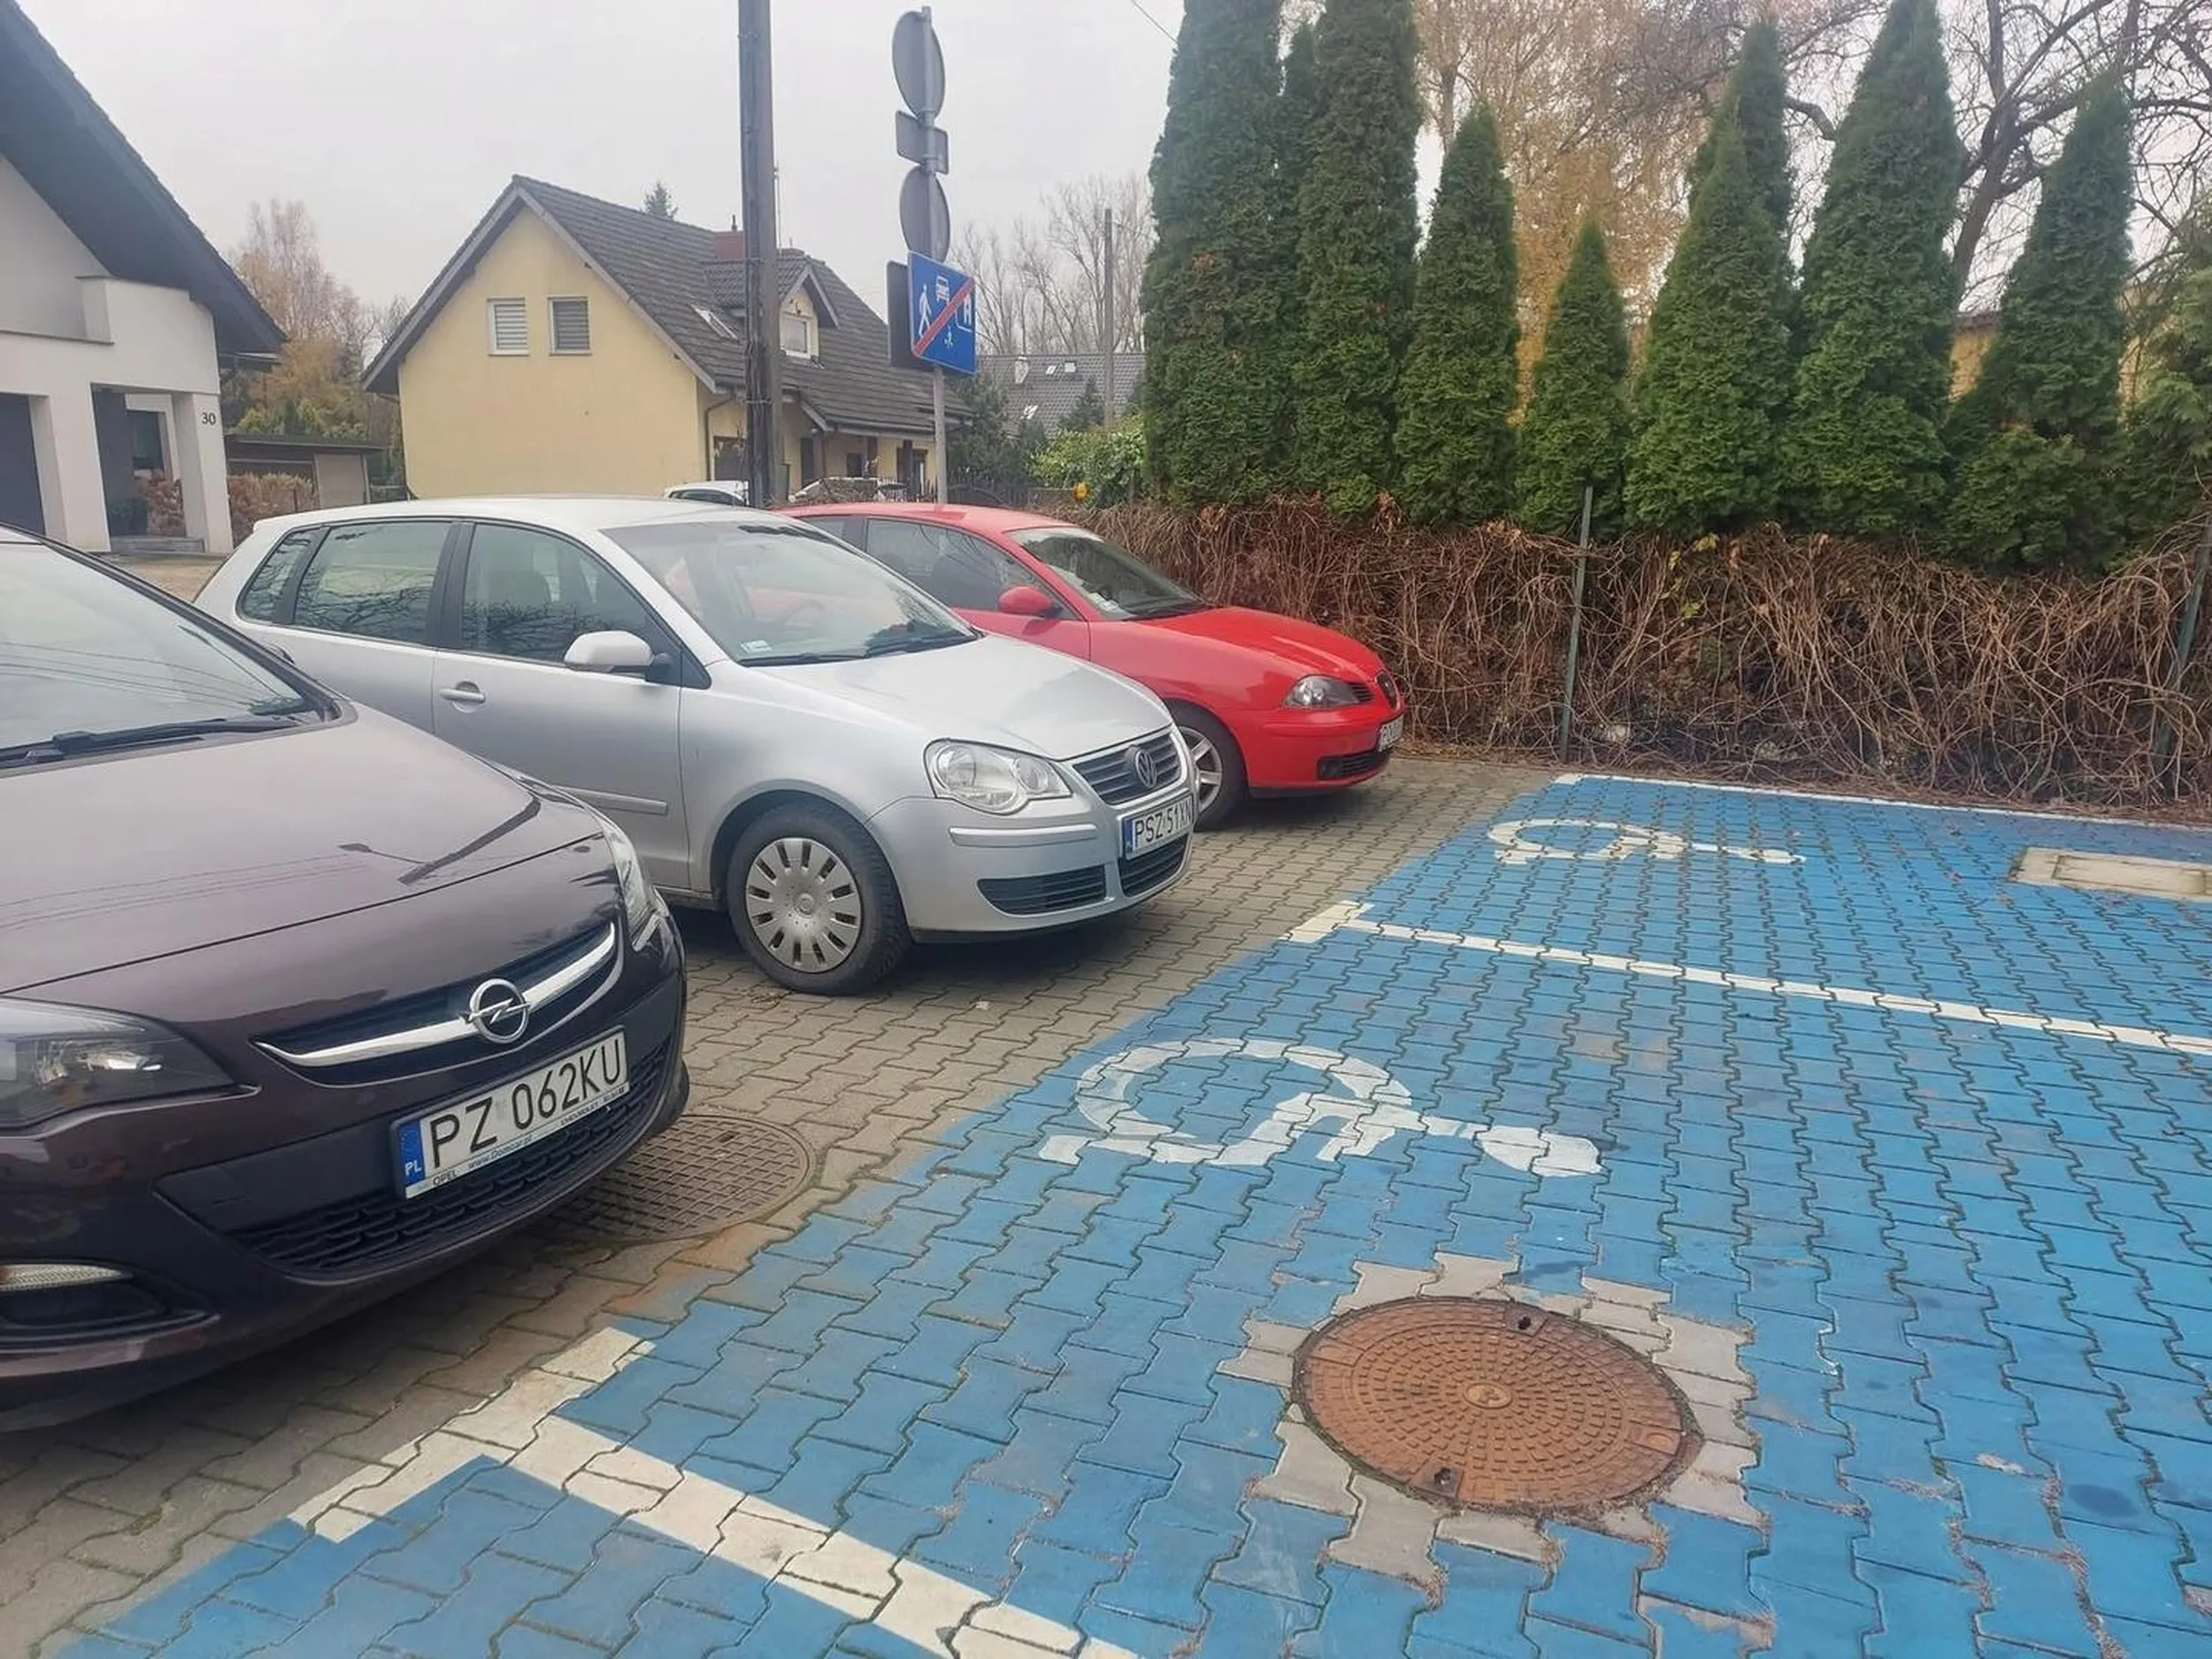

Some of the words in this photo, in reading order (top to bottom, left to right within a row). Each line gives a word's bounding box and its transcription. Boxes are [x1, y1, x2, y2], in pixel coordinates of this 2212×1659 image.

[201, 411, 217, 426] 30
[1135, 812, 1164, 848] PSZ
[429, 1096, 498, 1170] PZ
[511, 1038, 620, 1130] 062KU
[404, 1159, 422, 1176] PL
[432, 1170, 457, 1187] OPEL
